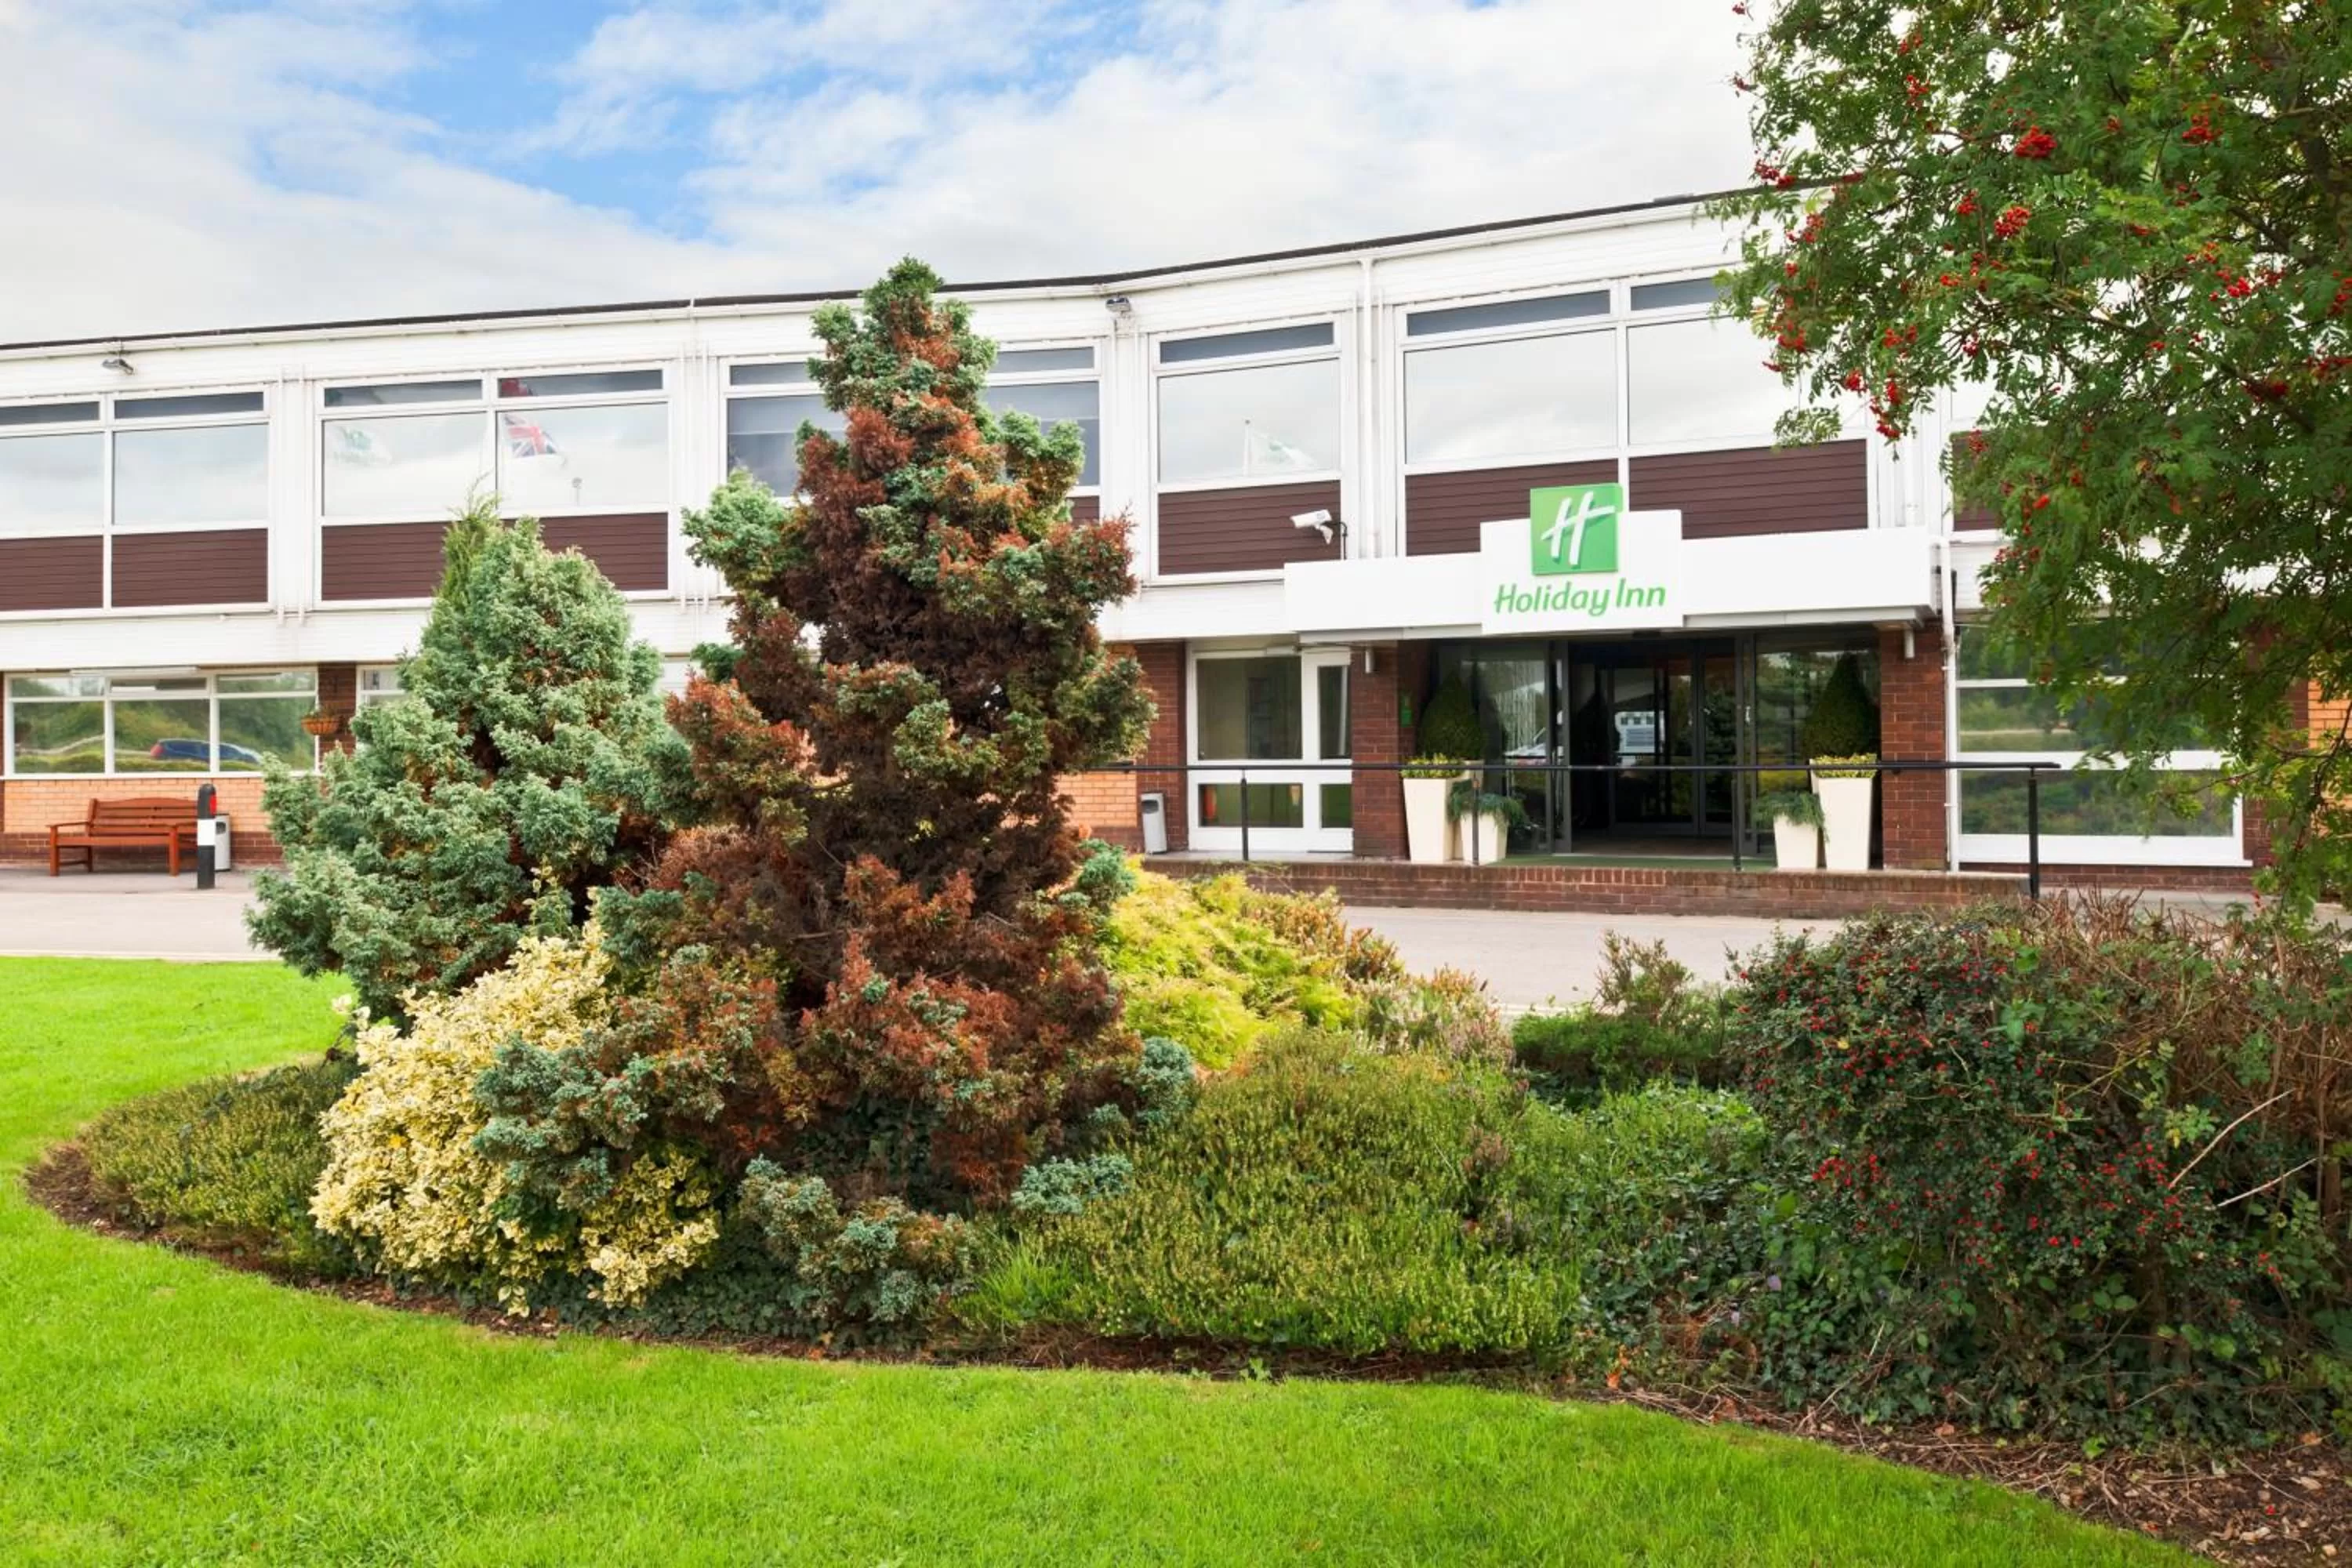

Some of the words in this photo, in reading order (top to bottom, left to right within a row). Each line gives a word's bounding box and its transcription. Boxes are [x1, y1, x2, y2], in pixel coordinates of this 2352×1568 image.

[1541, 491, 1616, 566] H
[1494, 581, 1610, 616] Holiday
[1616, 578, 1666, 608] Inn
